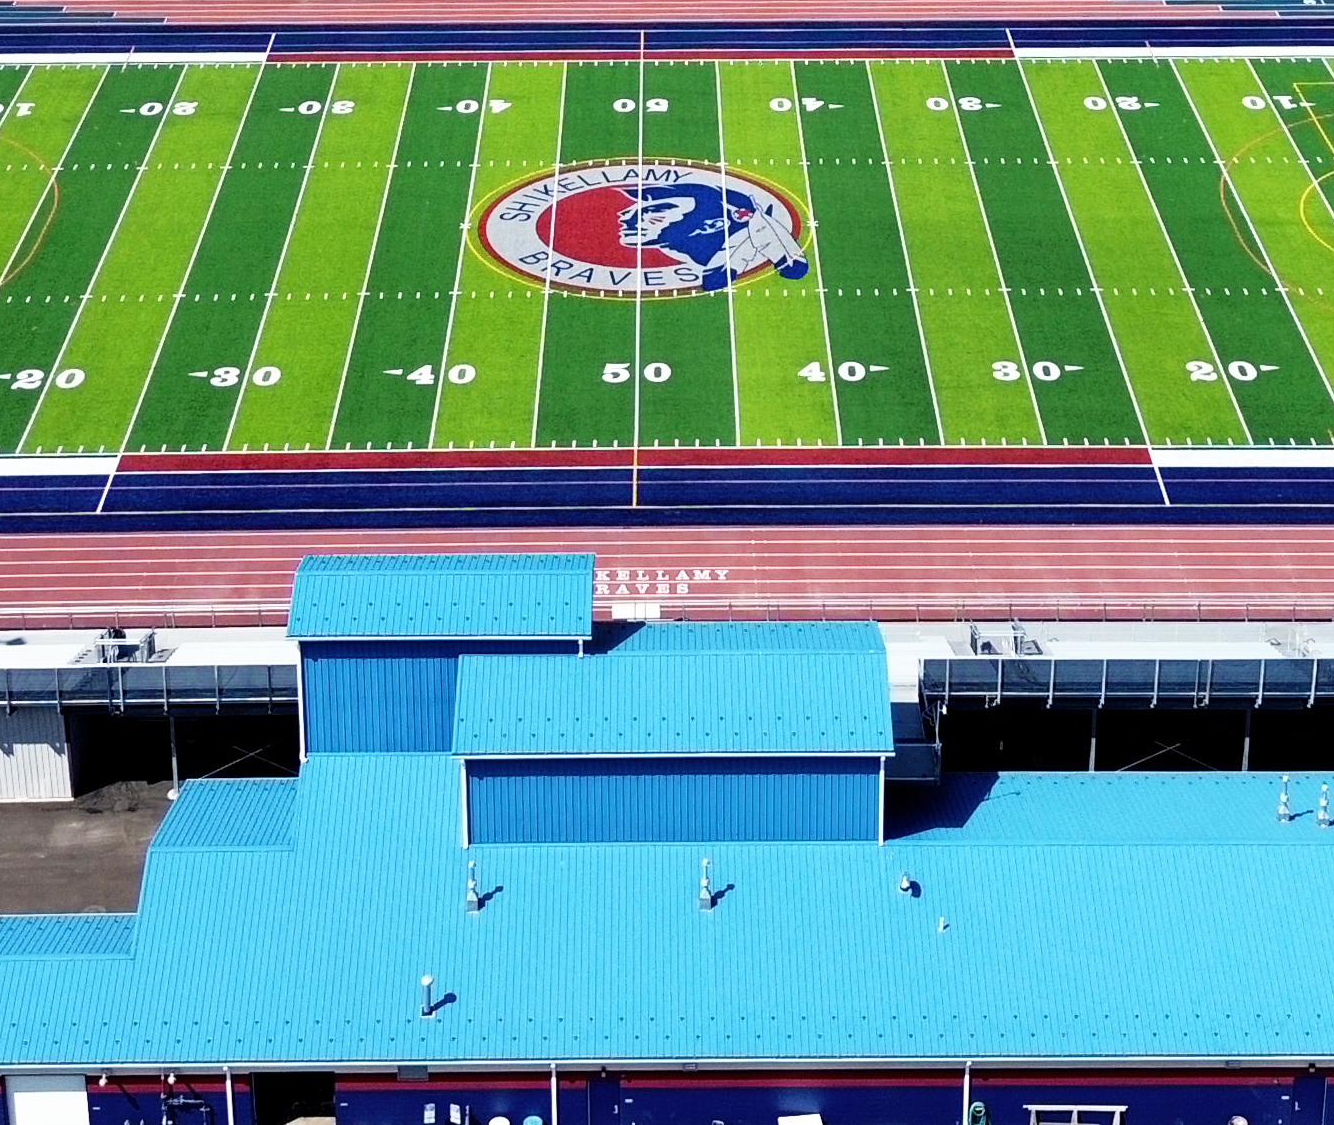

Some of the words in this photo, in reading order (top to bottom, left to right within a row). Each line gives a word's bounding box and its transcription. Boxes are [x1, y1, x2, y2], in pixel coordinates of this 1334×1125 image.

[137, 101, 198, 116] 20
[296, 100, 355, 115] 30
[454, 99, 512, 114] 40
[613, 98, 669, 113] 50
[769, 97, 825, 112] 40
[926, 96, 983, 112] 30
[1083, 96, 1142, 111] 20
[1242, 95, 1300, 111] 10
[499, 168, 694, 222] SHIKELLAMY
[519, 250, 699, 286] BRAVES
[10, 368, 87, 390] 20
[208, 366, 282, 388] 30
[403, 364, 477, 386] 40
[601, 362, 671, 383] 50
[797, 361, 867, 382] 40
[992, 361, 1061, 382] 30
[1186, 360, 1258, 382] 20
[595, 570, 730, 581] KELLAMY
[595, 583, 689, 595] RAVES
